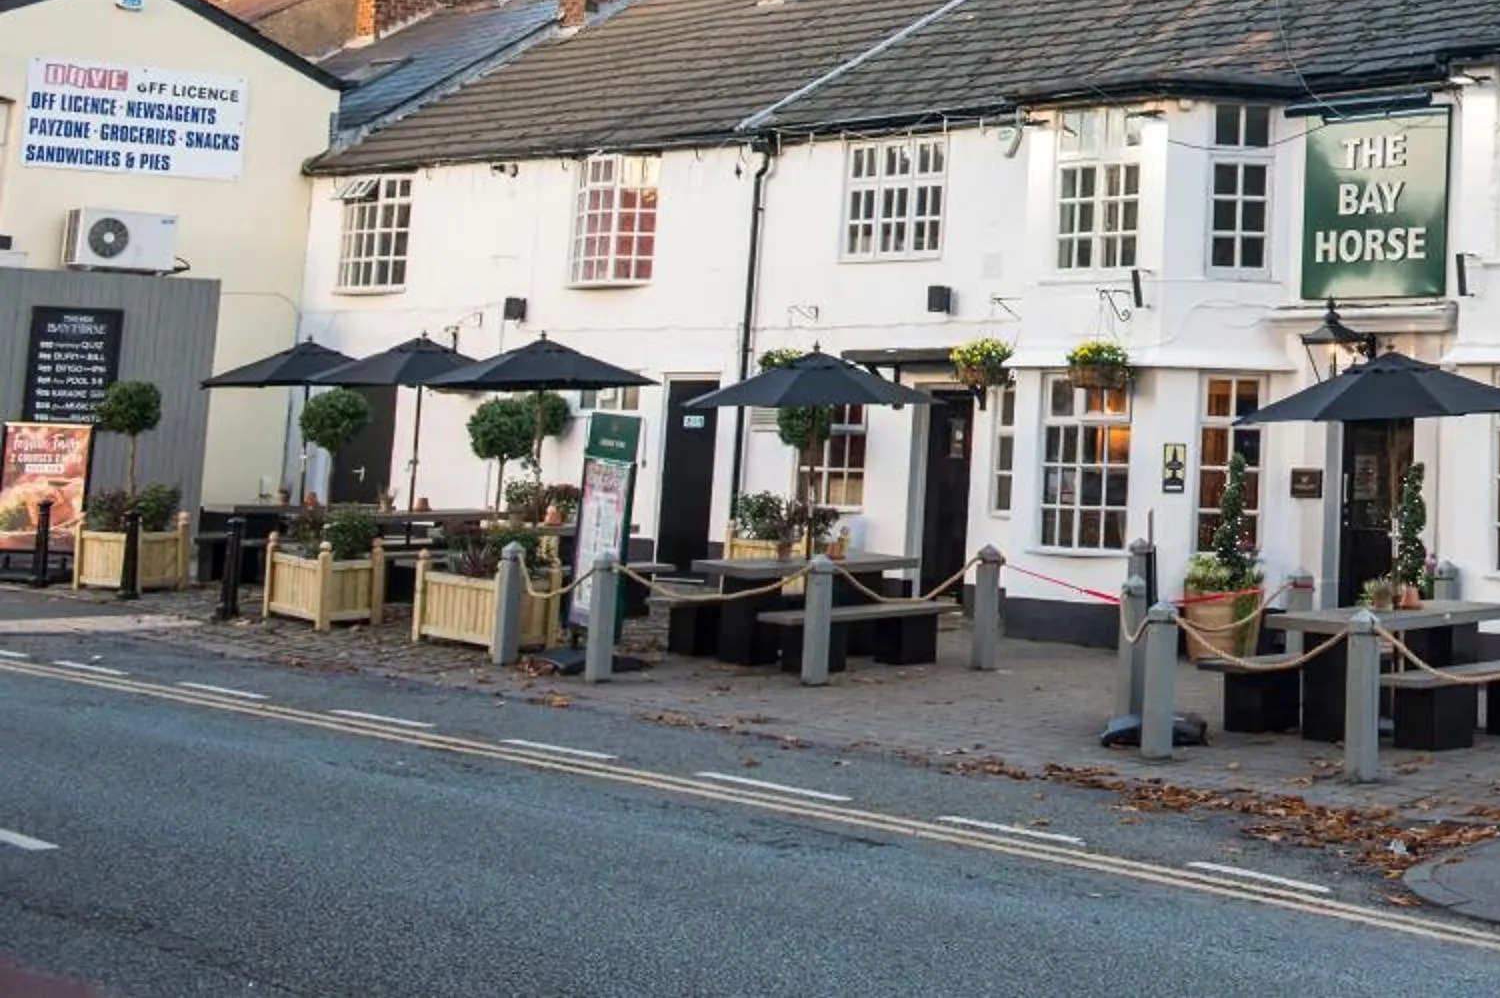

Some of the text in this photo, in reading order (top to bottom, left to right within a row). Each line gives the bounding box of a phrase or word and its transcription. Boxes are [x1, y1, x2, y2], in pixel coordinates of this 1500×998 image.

[31, 91, 217, 125] OFF LICENCE NEWSAGENTS
[137, 82, 167, 94] OFF
[172, 83, 240, 102] LICENCE
[28, 117, 240, 151] PAYZONE GROCERIES SNACKS
[25, 144, 171, 171] SANDWICHES & PIES
[1342, 134, 1408, 170] THE
[1338, 180, 1406, 216] BAY
[1315, 226, 1427, 264] HORSE
